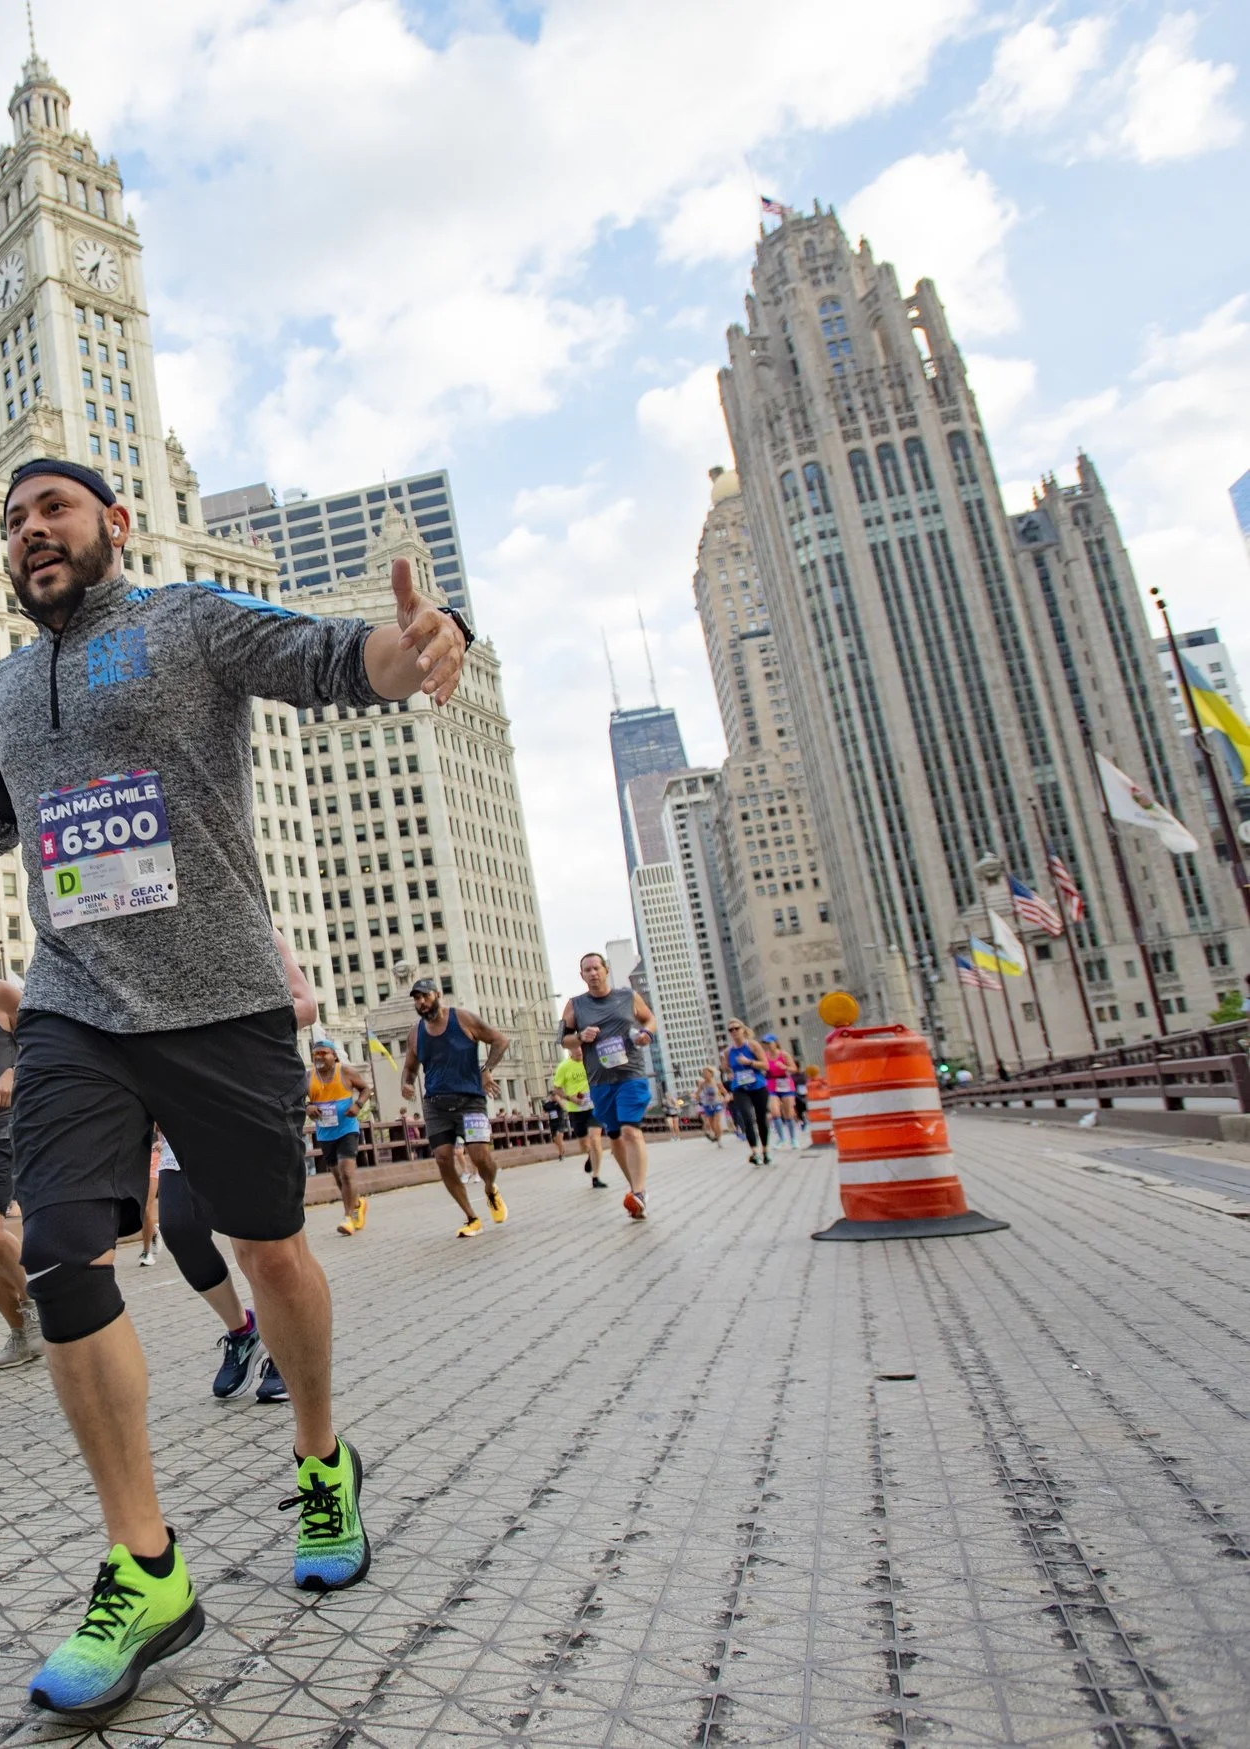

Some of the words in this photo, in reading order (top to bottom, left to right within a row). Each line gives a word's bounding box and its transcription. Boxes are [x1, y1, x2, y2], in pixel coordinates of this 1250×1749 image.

[88, 658, 151, 692] MILE
[40, 802, 72, 823] RUN
[72, 792, 114, 814] MAG
[114, 784, 159, 805] MILE
[62, 810, 159, 855] 6300
[44, 838, 54, 854] 5K
[58, 872, 76, 895] D
[131, 884, 163, 897] GEAR
[77, 892, 108, 905] DRINK
[129, 893, 169, 908] CHECK
